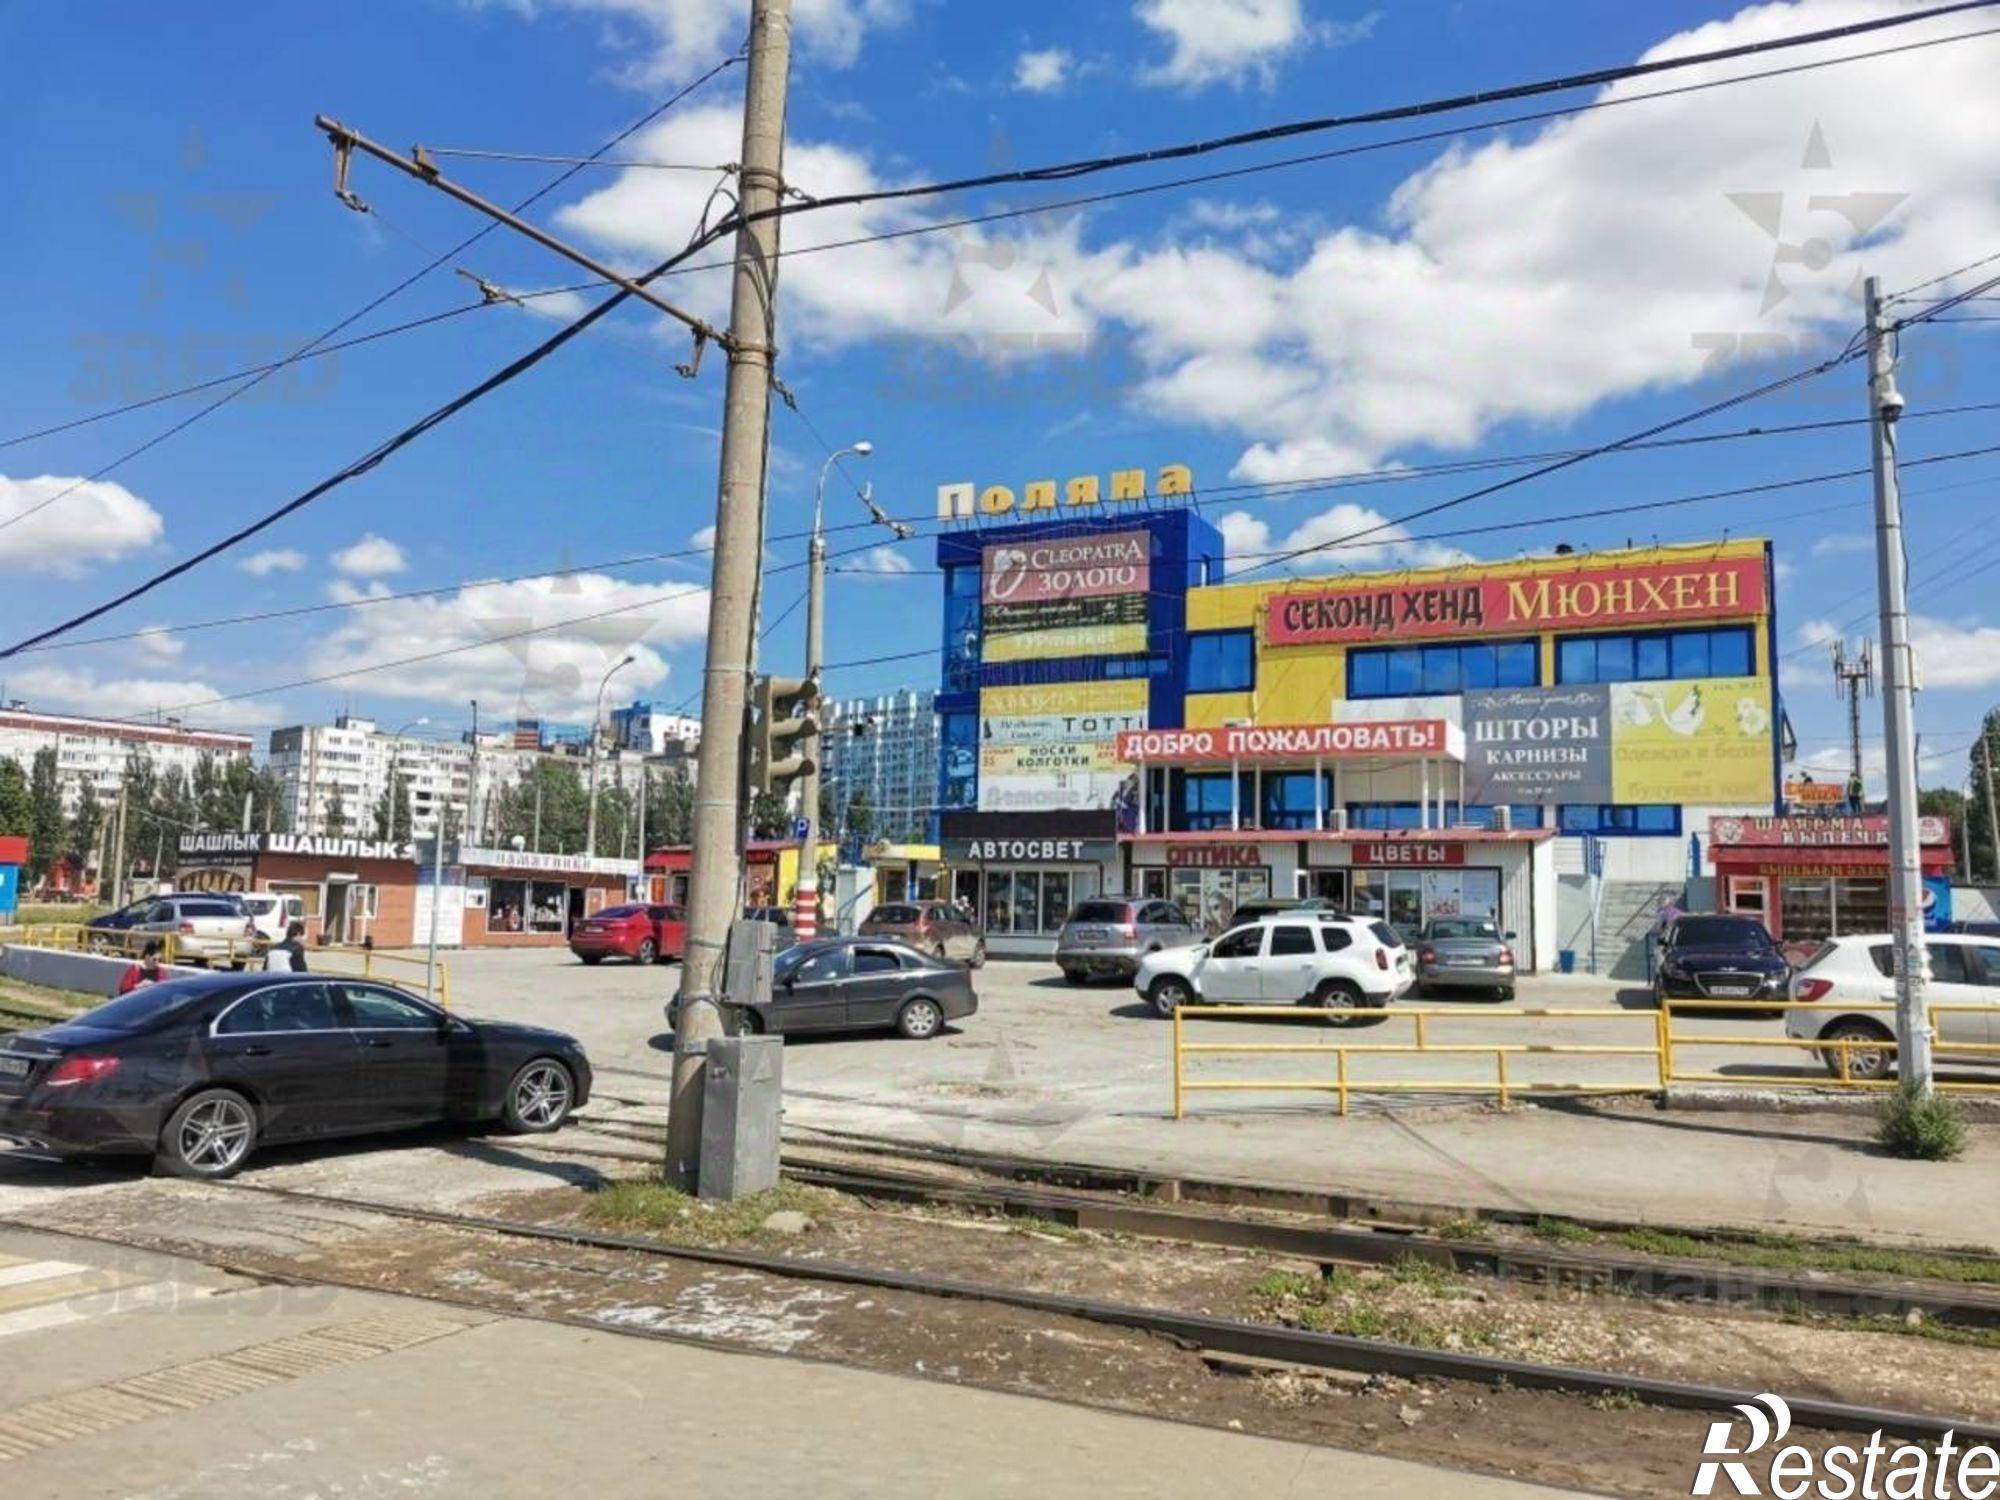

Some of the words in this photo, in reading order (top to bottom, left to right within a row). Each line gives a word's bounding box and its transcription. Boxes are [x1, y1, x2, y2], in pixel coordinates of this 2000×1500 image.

[937, 463, 1192, 521] Поляна
[1038, 564, 1137, 593] ЗОЛОТО
[1283, 596, 1396, 634] СЕКОНД
[1400, 586, 1485, 627] ХЕНД
[1474, 716, 1599, 743] ШТОРЫ
[1029, 745, 1077, 757] НОСКИ
[1123, 733, 1214, 760] ДОБРО
[1227, 724, 1437, 754] ПОЖАЛОВАТЬ!
[1016, 755, 1090, 769] КОЛГОТКИ
[1486, 747, 1589, 765] КАРНИЗЫ
[180, 833, 260, 852] ШАШЛЫК
[268, 832, 400, 860] ШАШЛЫК
[967, 841, 1084, 860] АВТОСВЕТ
[1168, 846, 1261, 867] ОПТИКА
[1369, 844, 1447, 864] ЦВЕТЫ
